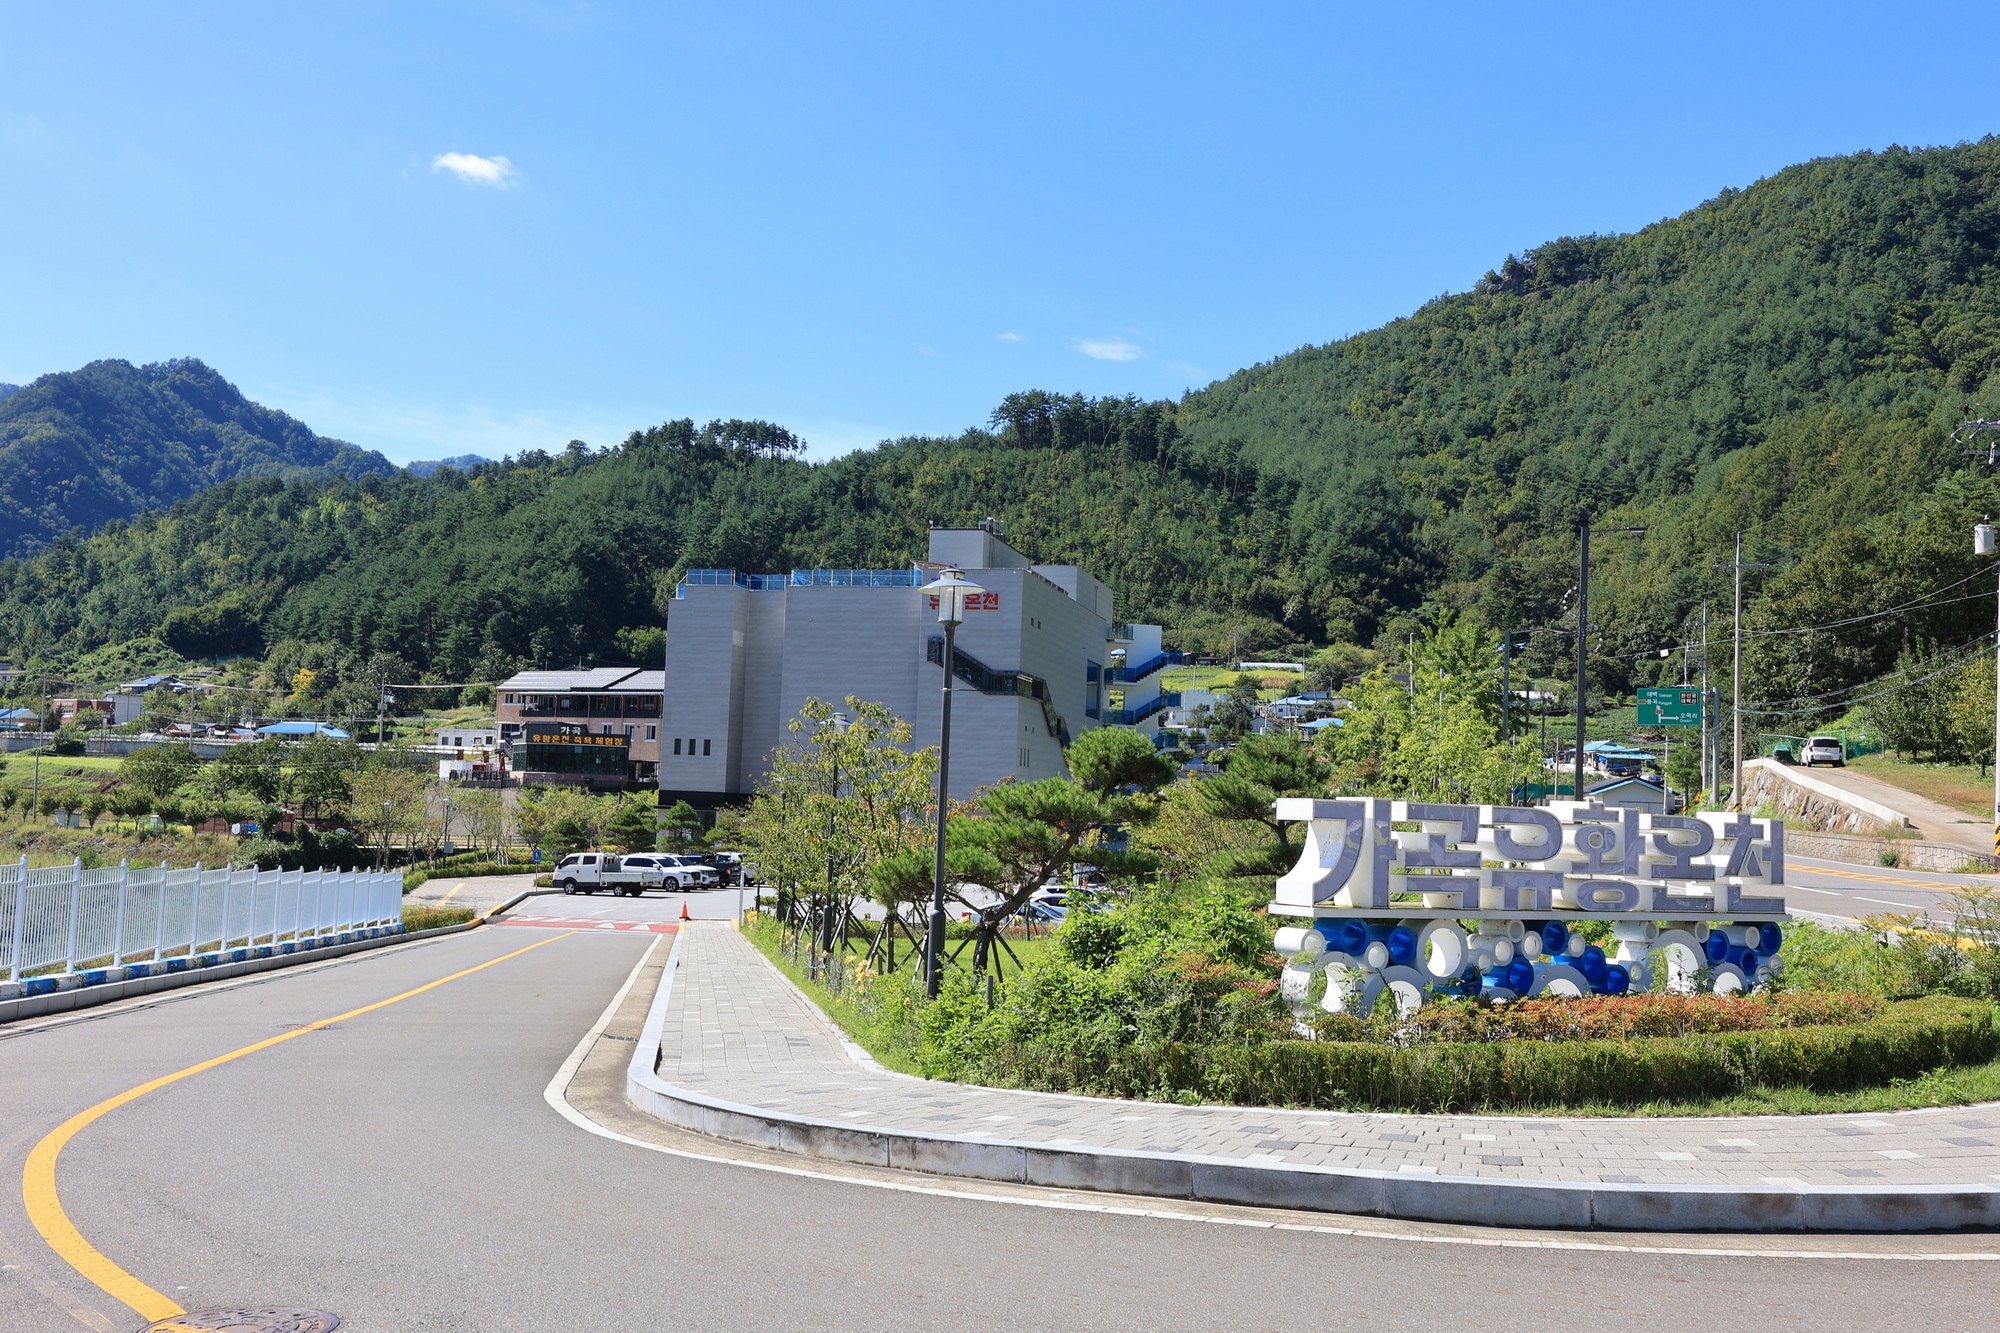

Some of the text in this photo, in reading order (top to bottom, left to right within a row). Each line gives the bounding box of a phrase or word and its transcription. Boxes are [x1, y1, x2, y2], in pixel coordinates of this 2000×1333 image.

[929, 593, 999, 610] 유온천
[560, 726, 582, 735] 가곡
[532, 734, 623, 746] 유황온천 족욕 체험장
